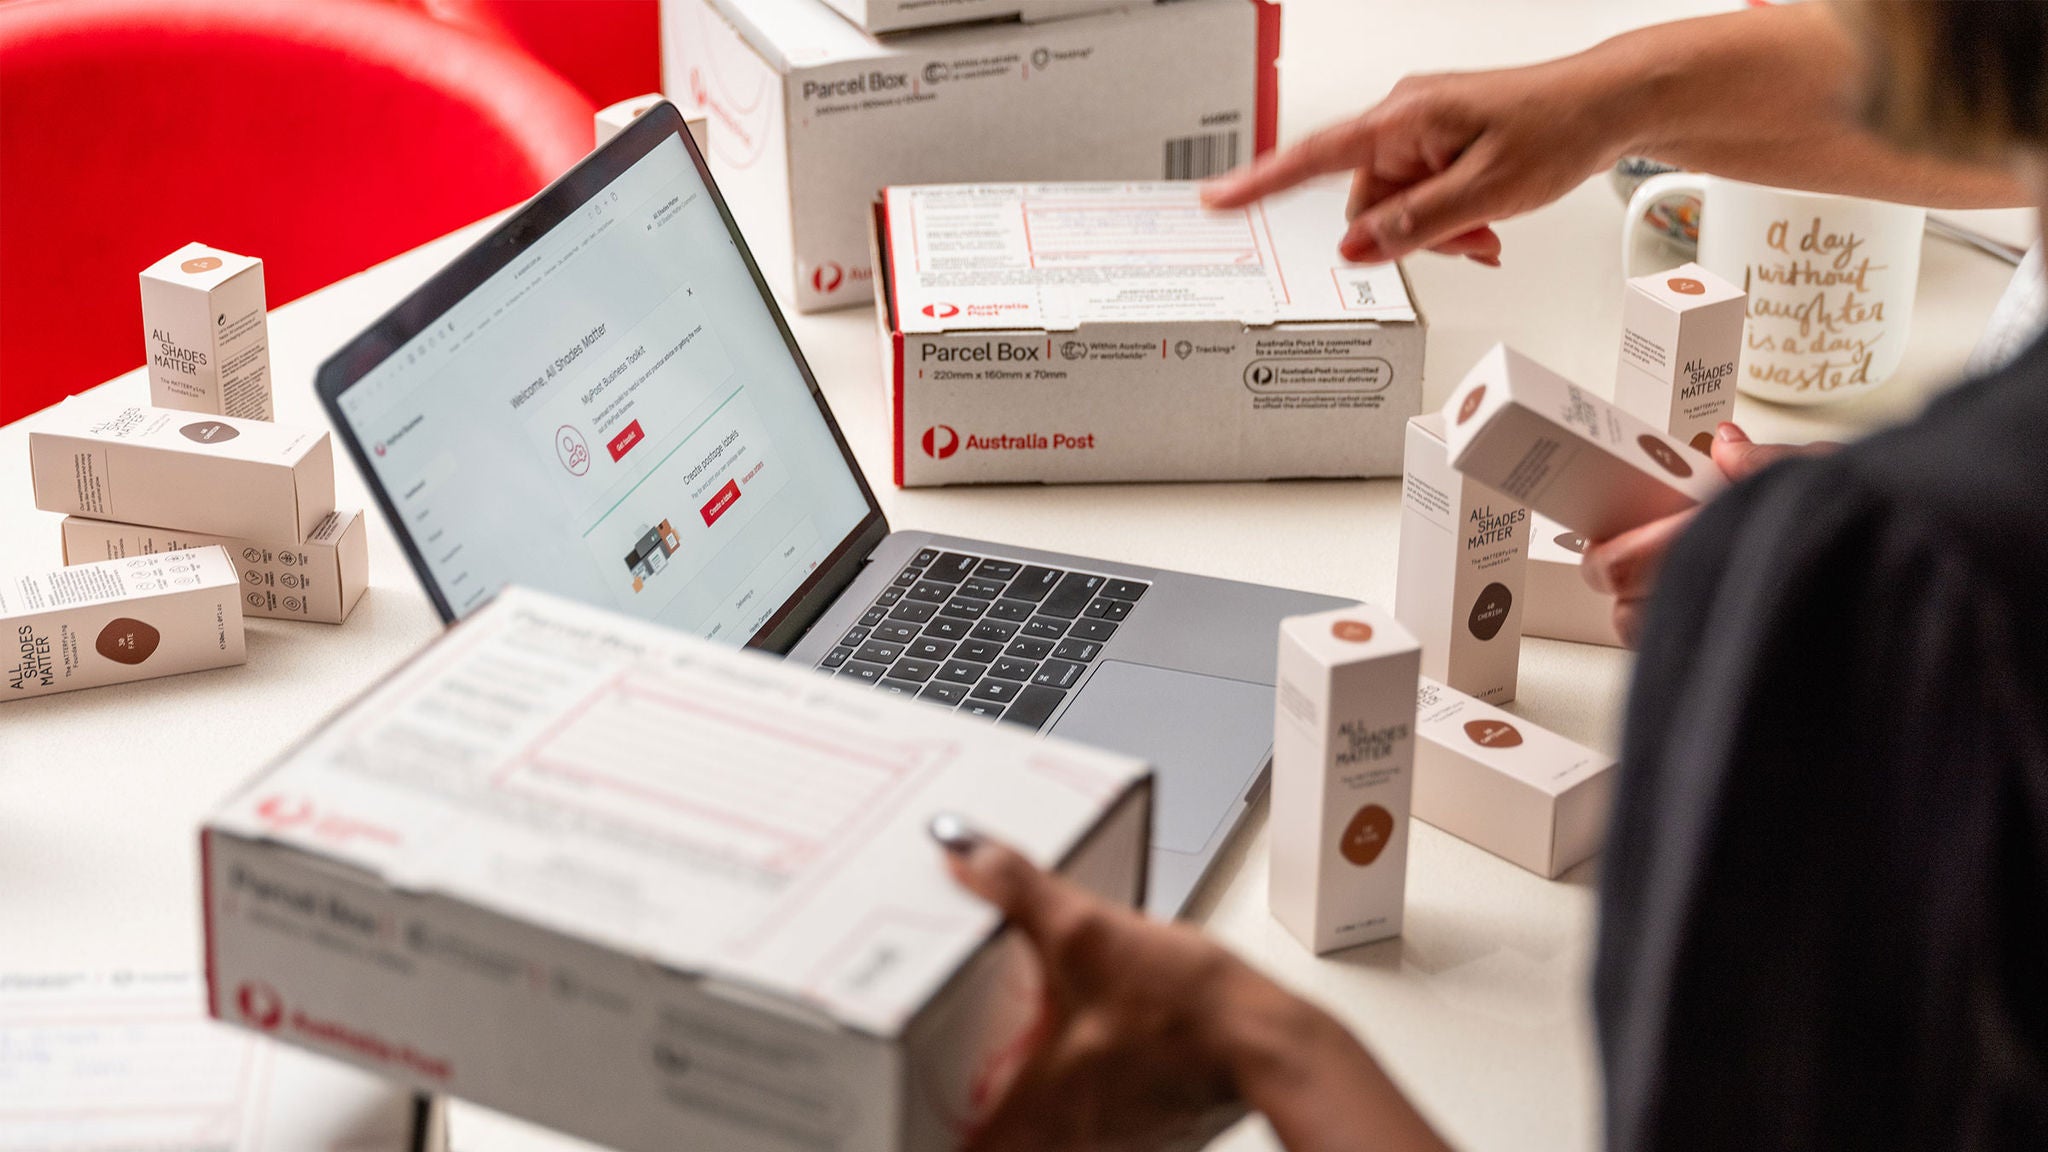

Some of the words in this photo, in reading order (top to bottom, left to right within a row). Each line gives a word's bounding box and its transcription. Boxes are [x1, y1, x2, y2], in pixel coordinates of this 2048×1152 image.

[802, 76, 866, 100] Parcel
[868, 72, 909, 91] Box
[1766, 220, 1791, 254] a
[1801, 217, 1864, 269] day
[1758, 258, 1888, 293] without
[152, 329, 174, 345] ALL
[1256, 339, 1294, 347] Australia
[1326, 338, 1372, 346] committed
[1748, 324, 1775, 350] is
[1782, 337, 1806, 355] a
[1810, 331, 1885, 364] day
[161, 343, 207, 366] SHADES
[922, 342, 992, 361] Parcel
[998, 342, 1039, 361] Box
[154, 354, 197, 376] MATTER
[510, 377, 548, 409] Welcome,
[546, 365, 556, 381] All
[555, 345, 583, 372] Shades
[581, 323, 607, 349] Matter
[581, 383, 604, 405] MyPost
[603, 362, 627, 387] Business
[626, 345, 646, 365] Toolkit
[934, 370, 973, 380] 220mm
[985, 370, 1022, 380] 160mm
[1034, 369, 1067, 379] 70mm
[1684, 358, 1704, 375] ALL
[1690, 362, 1734, 385] SHADES
[167, 386, 199, 398] Foundation
[1681, 379, 1721, 401] MATTER
[966, 431, 1048, 449] Australia
[1053, 431, 1094, 449] Post
[683, 465, 703, 485] Create
[701, 444, 724, 470] postage
[721, 430, 740, 448] labels
[1470, 505, 1493, 522] ALL
[1478, 508, 1525, 534] SHADES
[1468, 526, 1512, 550] MATTER
[1472, 557, 1481, 566] The
[1477, 557, 1510, 570] Foundation
[1477, 608, 1503, 621] CHERISH
[18, 625, 38, 679] SHADES
[71, 631, 79, 669] Foundation
[127, 633, 135, 650] FATE
[36, 636, 54, 687] MATTER
[10, 664, 24, 690] ALL
[1337, 719, 1366, 737] ALL
[1350, 724, 1409, 746] SHADES
[1336, 743, 1393, 767] MATTER
